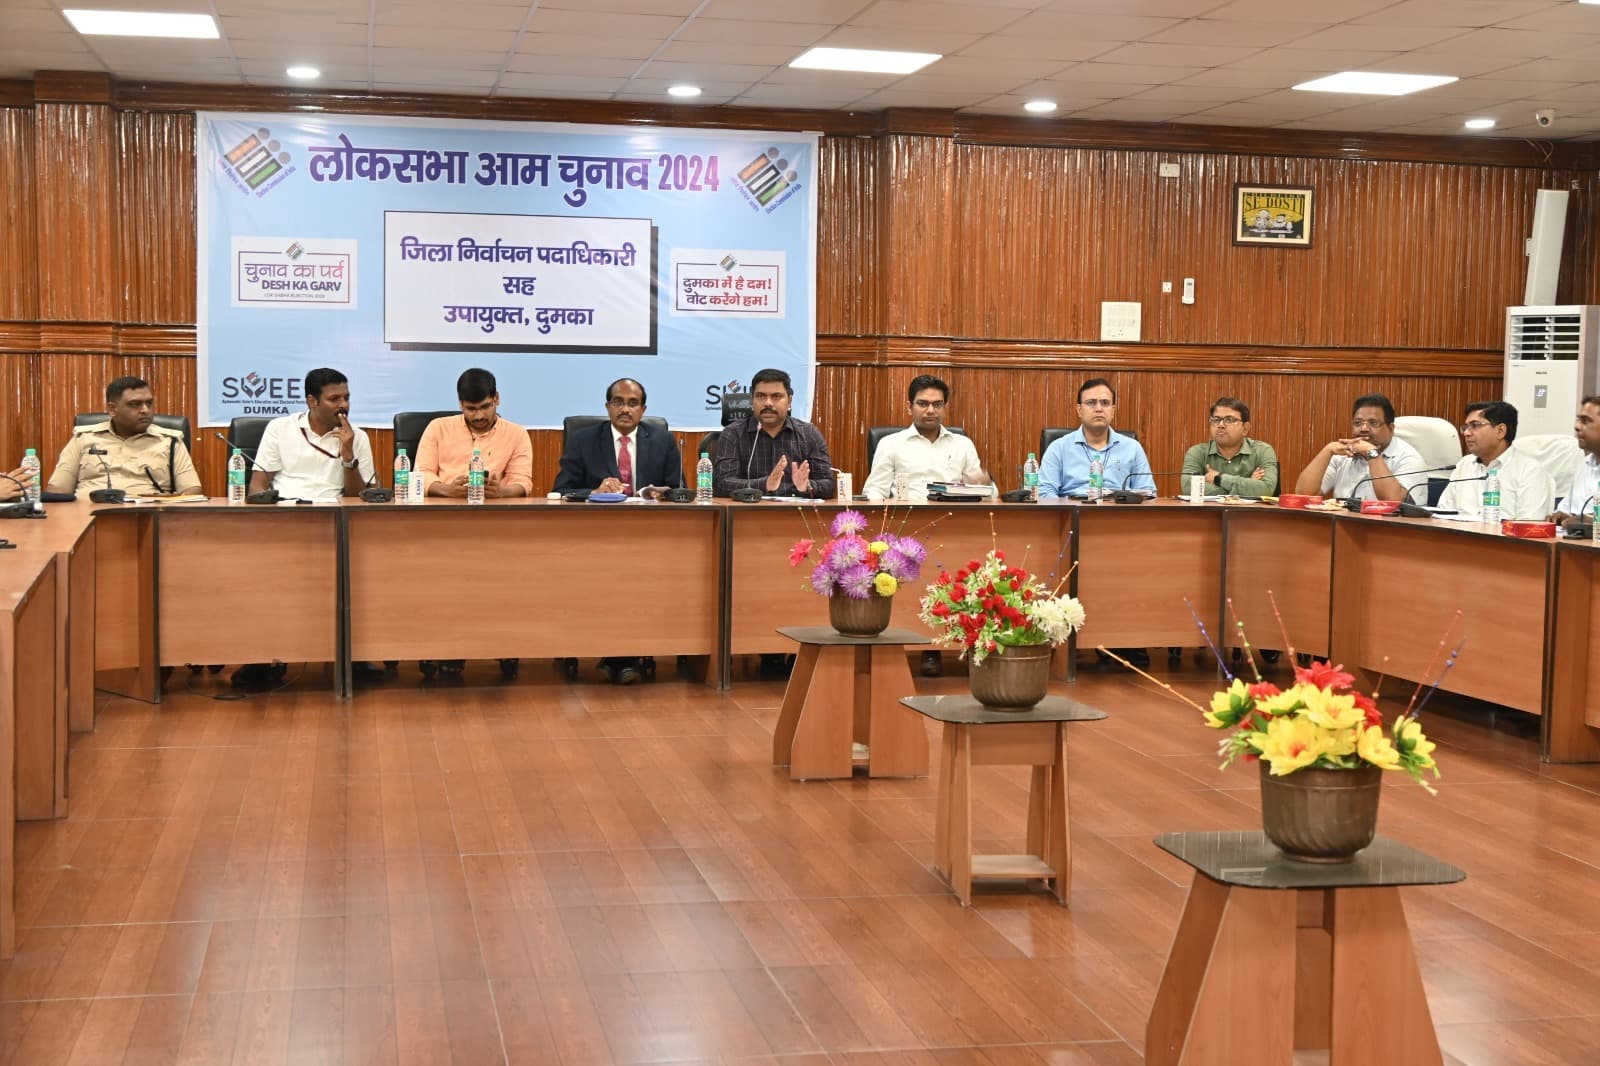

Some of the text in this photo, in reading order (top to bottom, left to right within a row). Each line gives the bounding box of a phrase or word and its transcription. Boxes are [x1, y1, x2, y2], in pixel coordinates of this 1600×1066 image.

[308, 133, 469, 184] लोकसभा
[474, 152, 551, 186] आम
[558, 155, 652, 207] चुनाव
[658, 154, 719, 192] 2024
[400, 236, 636, 266] जिला निर्वाचन पदाधिकारी
[244, 260, 344, 283] चुनाव का पर्व
[262, 280, 341, 291] DESH KA GARV
[503, 276, 536, 295] सह
[683, 278, 720, 293] दुमका
[722, 275, 733, 288] में
[735, 275, 744, 290] है
[686, 292, 708, 305] वोट
[709, 292, 740, 306] करेंगे
[443, 305, 594, 334] उपायुक्त, दुमका
[244, 406, 289, 415] DUMKA
